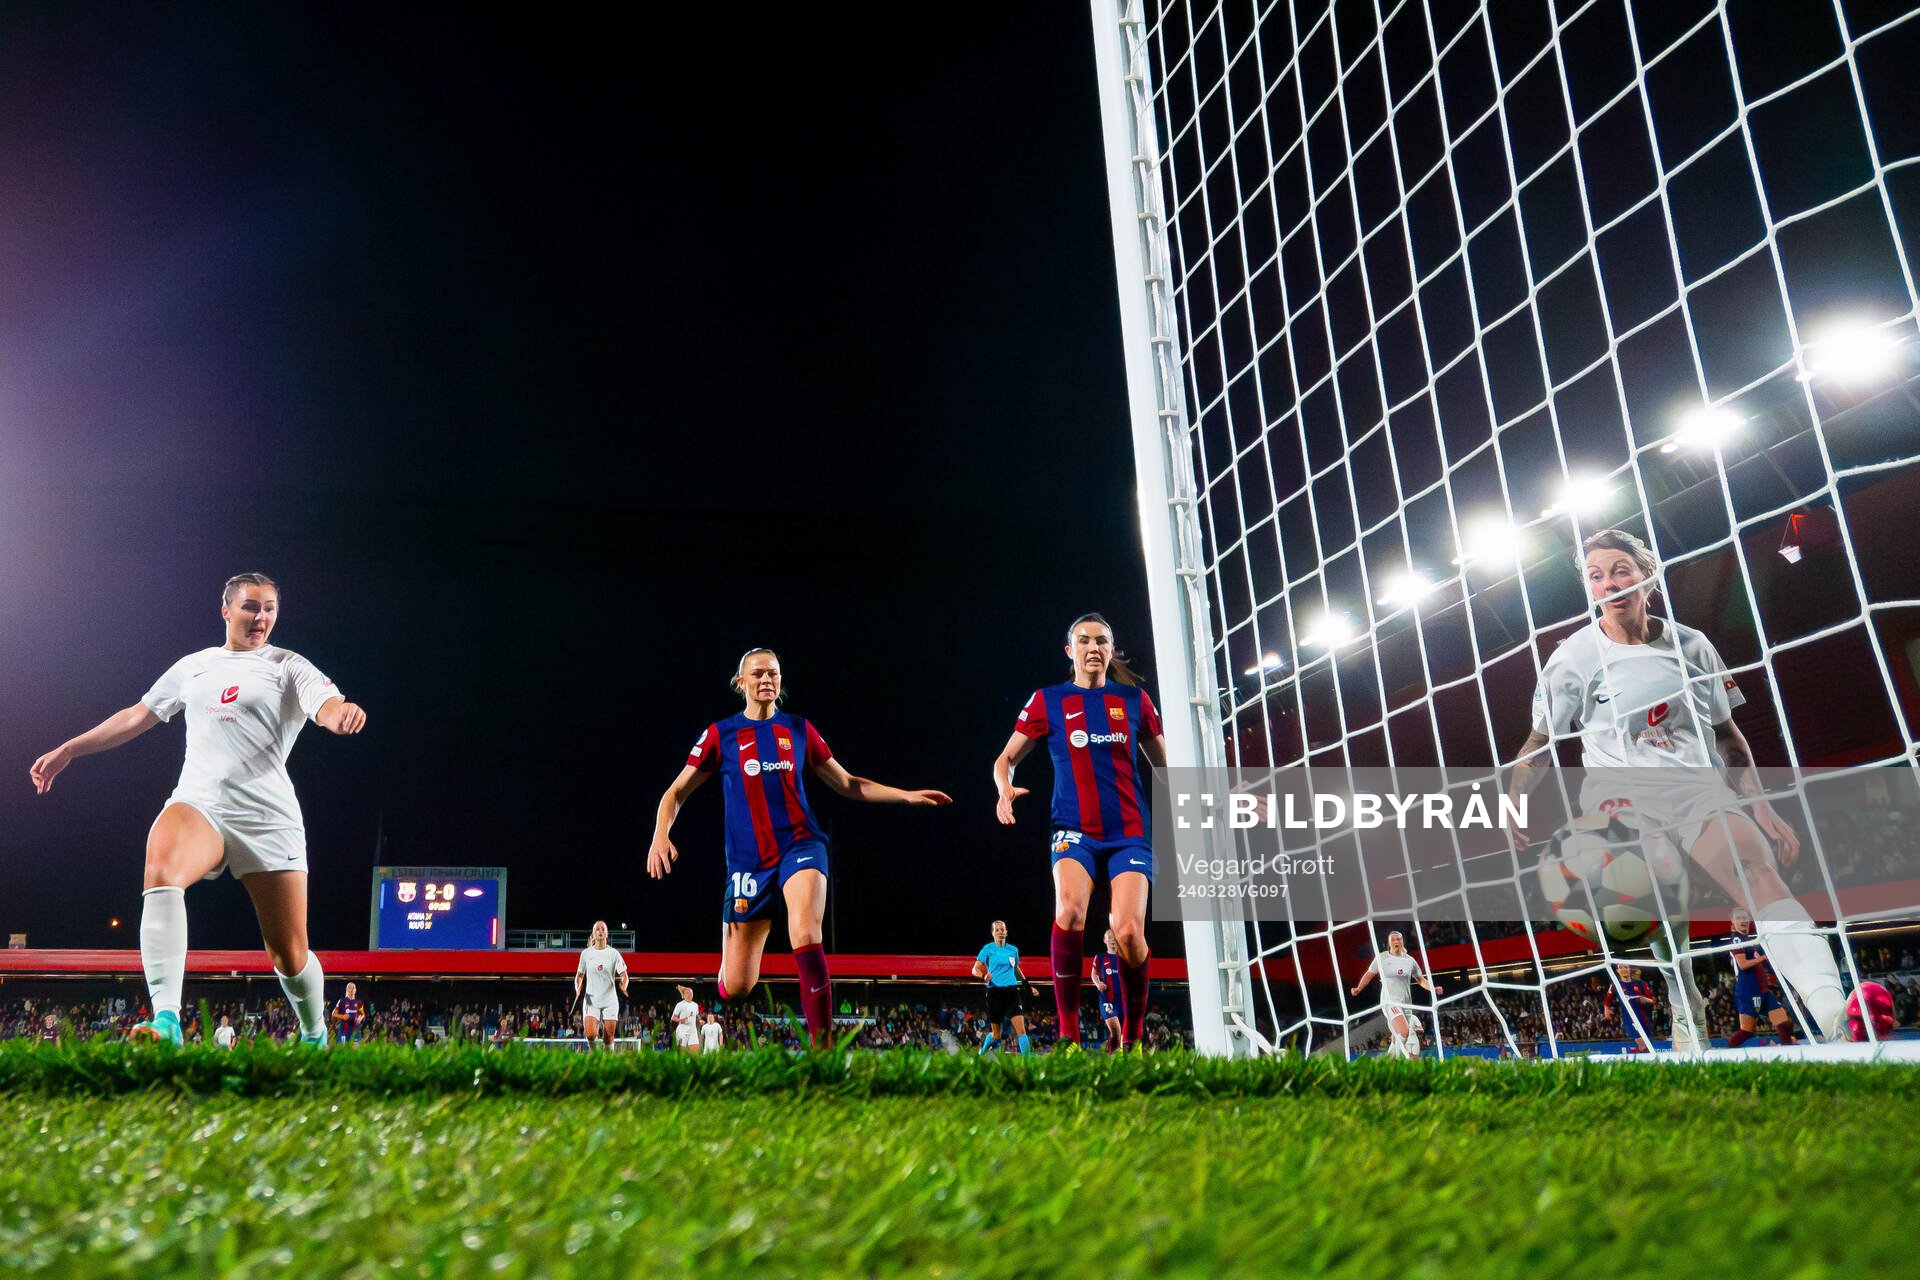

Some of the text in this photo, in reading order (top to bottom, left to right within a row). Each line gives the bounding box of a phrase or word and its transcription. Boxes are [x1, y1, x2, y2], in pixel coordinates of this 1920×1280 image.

[1090, 732, 1128, 744] Spotify
[762, 760, 794, 772] Spotify
[731, 871, 758, 898] 16
